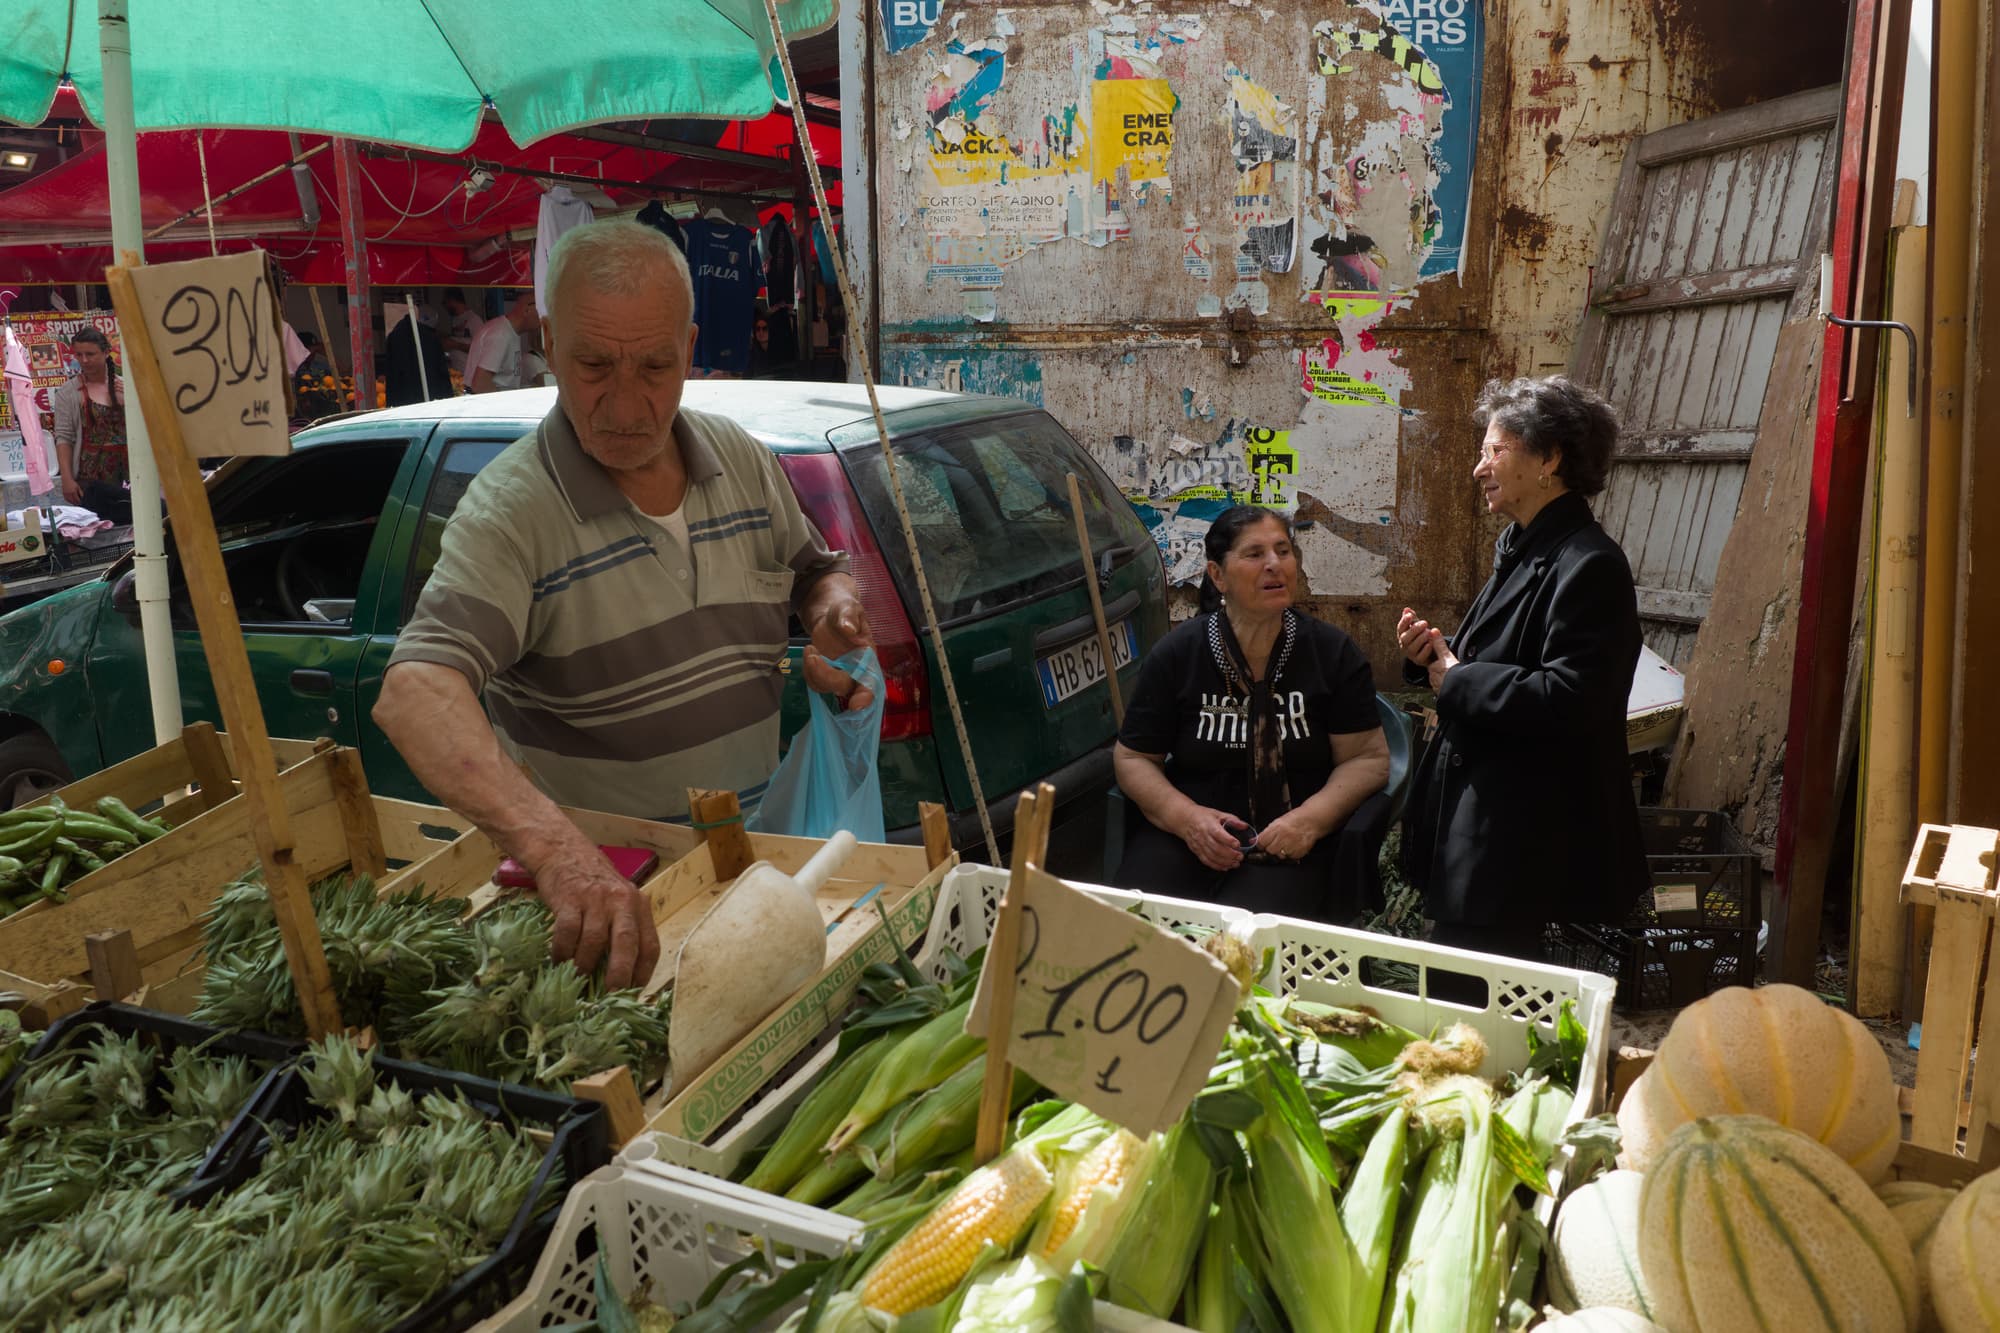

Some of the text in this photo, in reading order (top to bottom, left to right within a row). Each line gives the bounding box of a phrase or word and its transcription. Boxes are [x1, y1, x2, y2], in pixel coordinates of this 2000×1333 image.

[1123, 113, 1172, 128] EME
[1123, 131, 1172, 147] CRA
[698, 264, 740, 281] ITALIA
[161, 277, 270, 414] 3.00
[1051, 652, 1080, 697] HB
[1019, 944, 1188, 1045] 1.00
[713, 1003, 803, 1092] CONSORZIO
[804, 956, 857, 1013] FUNGHI
